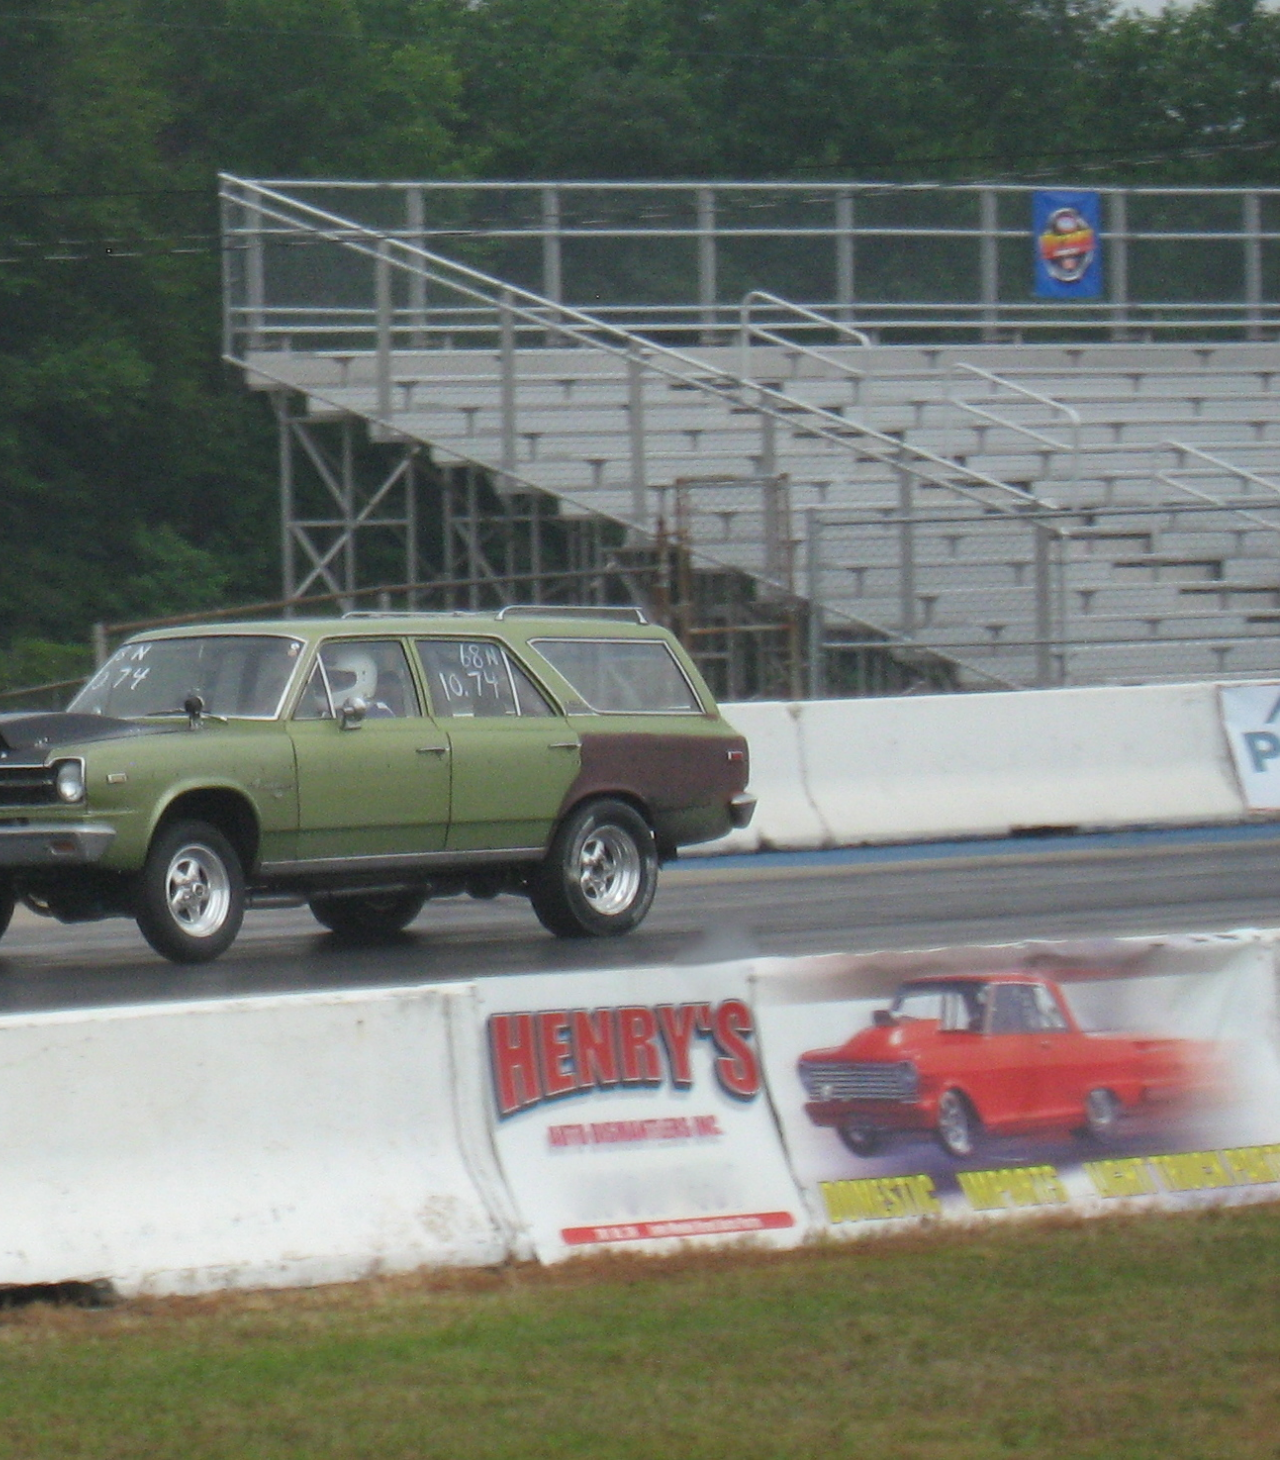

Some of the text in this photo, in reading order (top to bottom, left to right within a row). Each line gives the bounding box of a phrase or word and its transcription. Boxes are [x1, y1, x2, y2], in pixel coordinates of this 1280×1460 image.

[439, 670, 499, 701] 10.74
[487, 999, 762, 1122] HENRY'S
[819, 1174, 942, 1224] DOMESTIC
